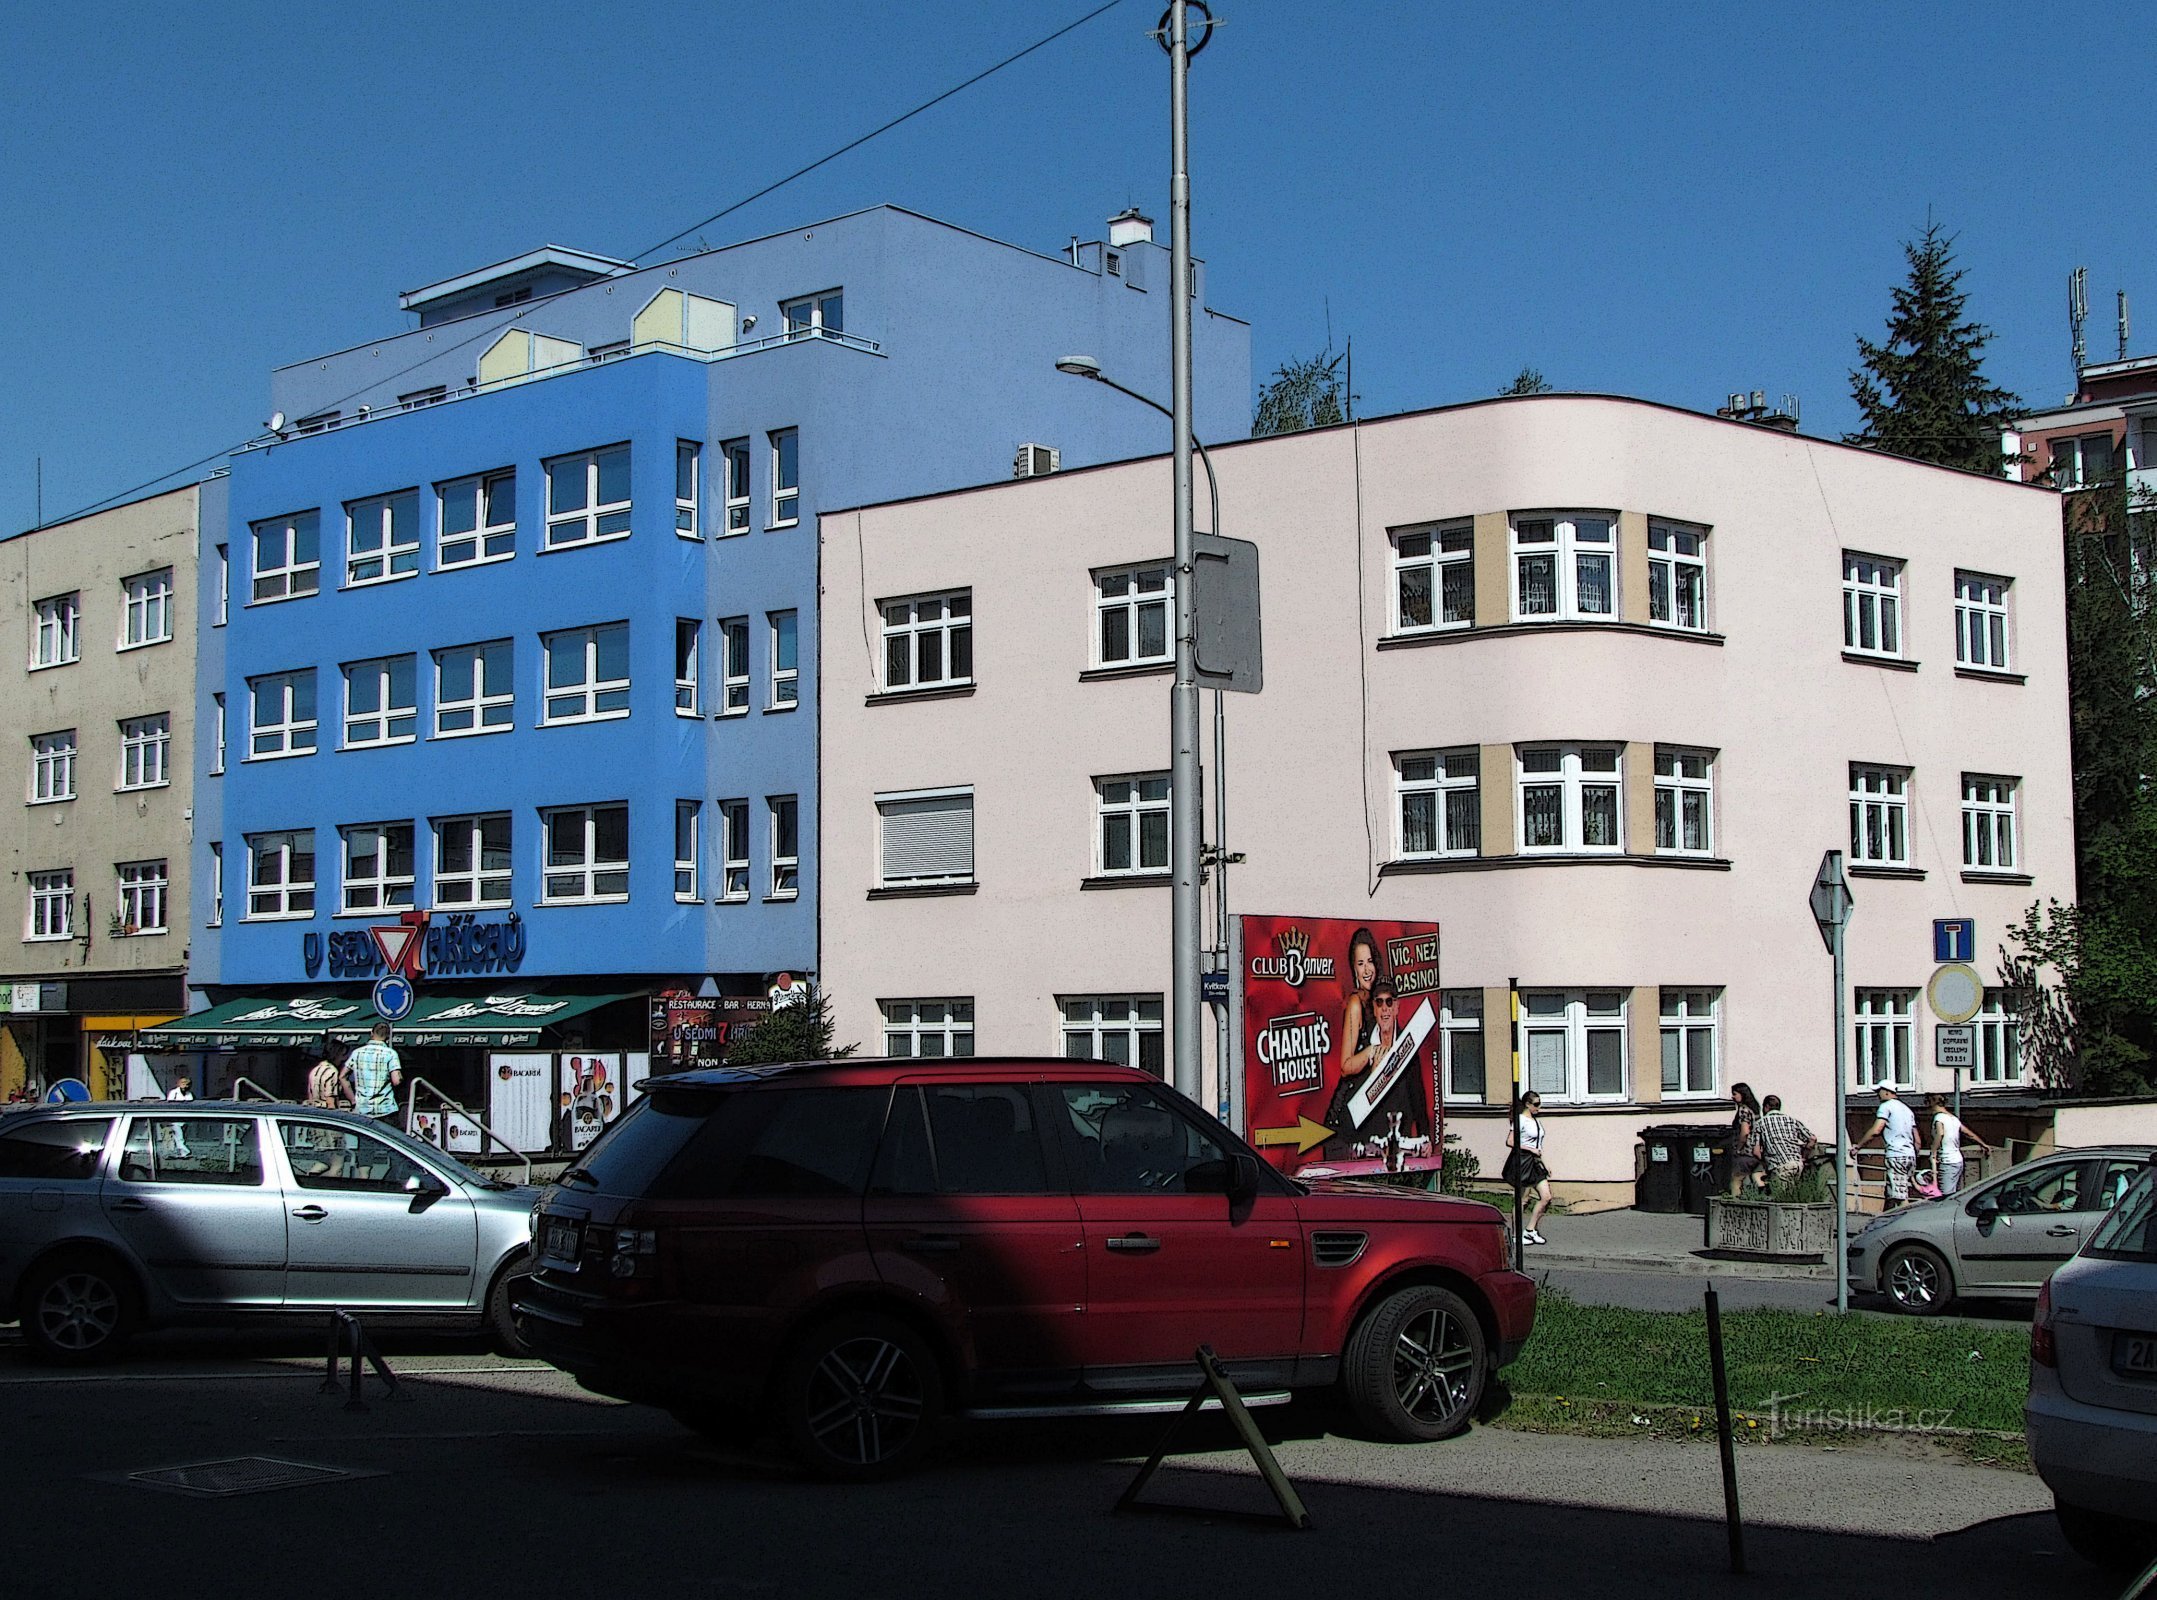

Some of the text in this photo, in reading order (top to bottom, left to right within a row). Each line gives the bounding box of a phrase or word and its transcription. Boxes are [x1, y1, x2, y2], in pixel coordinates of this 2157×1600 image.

[329, 930, 383, 969] SED
[1391, 937, 1437, 967] VÍC, NEŽ
[1252, 949, 1334, 985] CLUB Bonver
[1395, 967, 1438, 992] CASINO!
[669, 1001, 716, 1010] RESTAURACE
[724, 1001, 739, 1010] BAR
[746, 1001, 771, 1010] HERNA
[685, 1028, 717, 1040] SEDMI
[718, 1022, 729, 1044] 7
[697, 1059, 719, 1067] NON
[1279, 1057, 1317, 1084] HOUSE
[1432, 1051, 1440, 1144] www.bonver.eu
[2130, 1341, 2157, 1369] 2A
